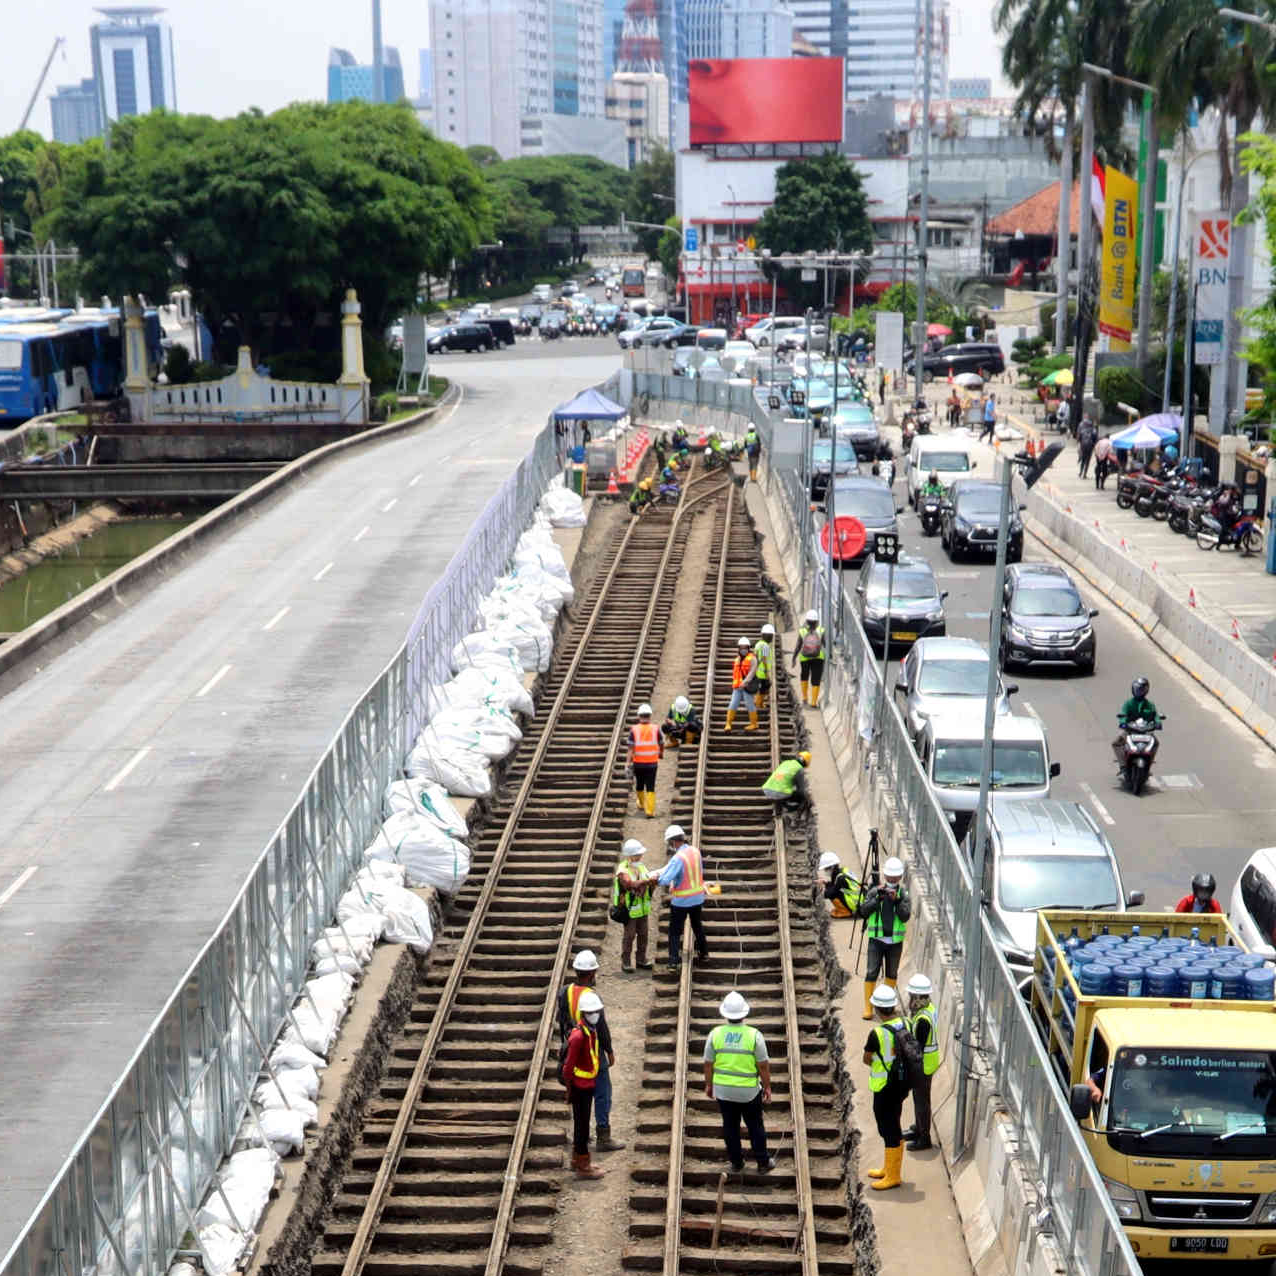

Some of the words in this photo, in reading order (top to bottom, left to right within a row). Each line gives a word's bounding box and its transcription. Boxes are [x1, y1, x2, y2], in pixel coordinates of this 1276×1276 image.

[1114, 199, 1128, 237] BTN
[1111, 264, 1125, 300] Bank
[1198, 267, 1228, 286] BN
[1160, 1055, 1208, 1067] Salindo
